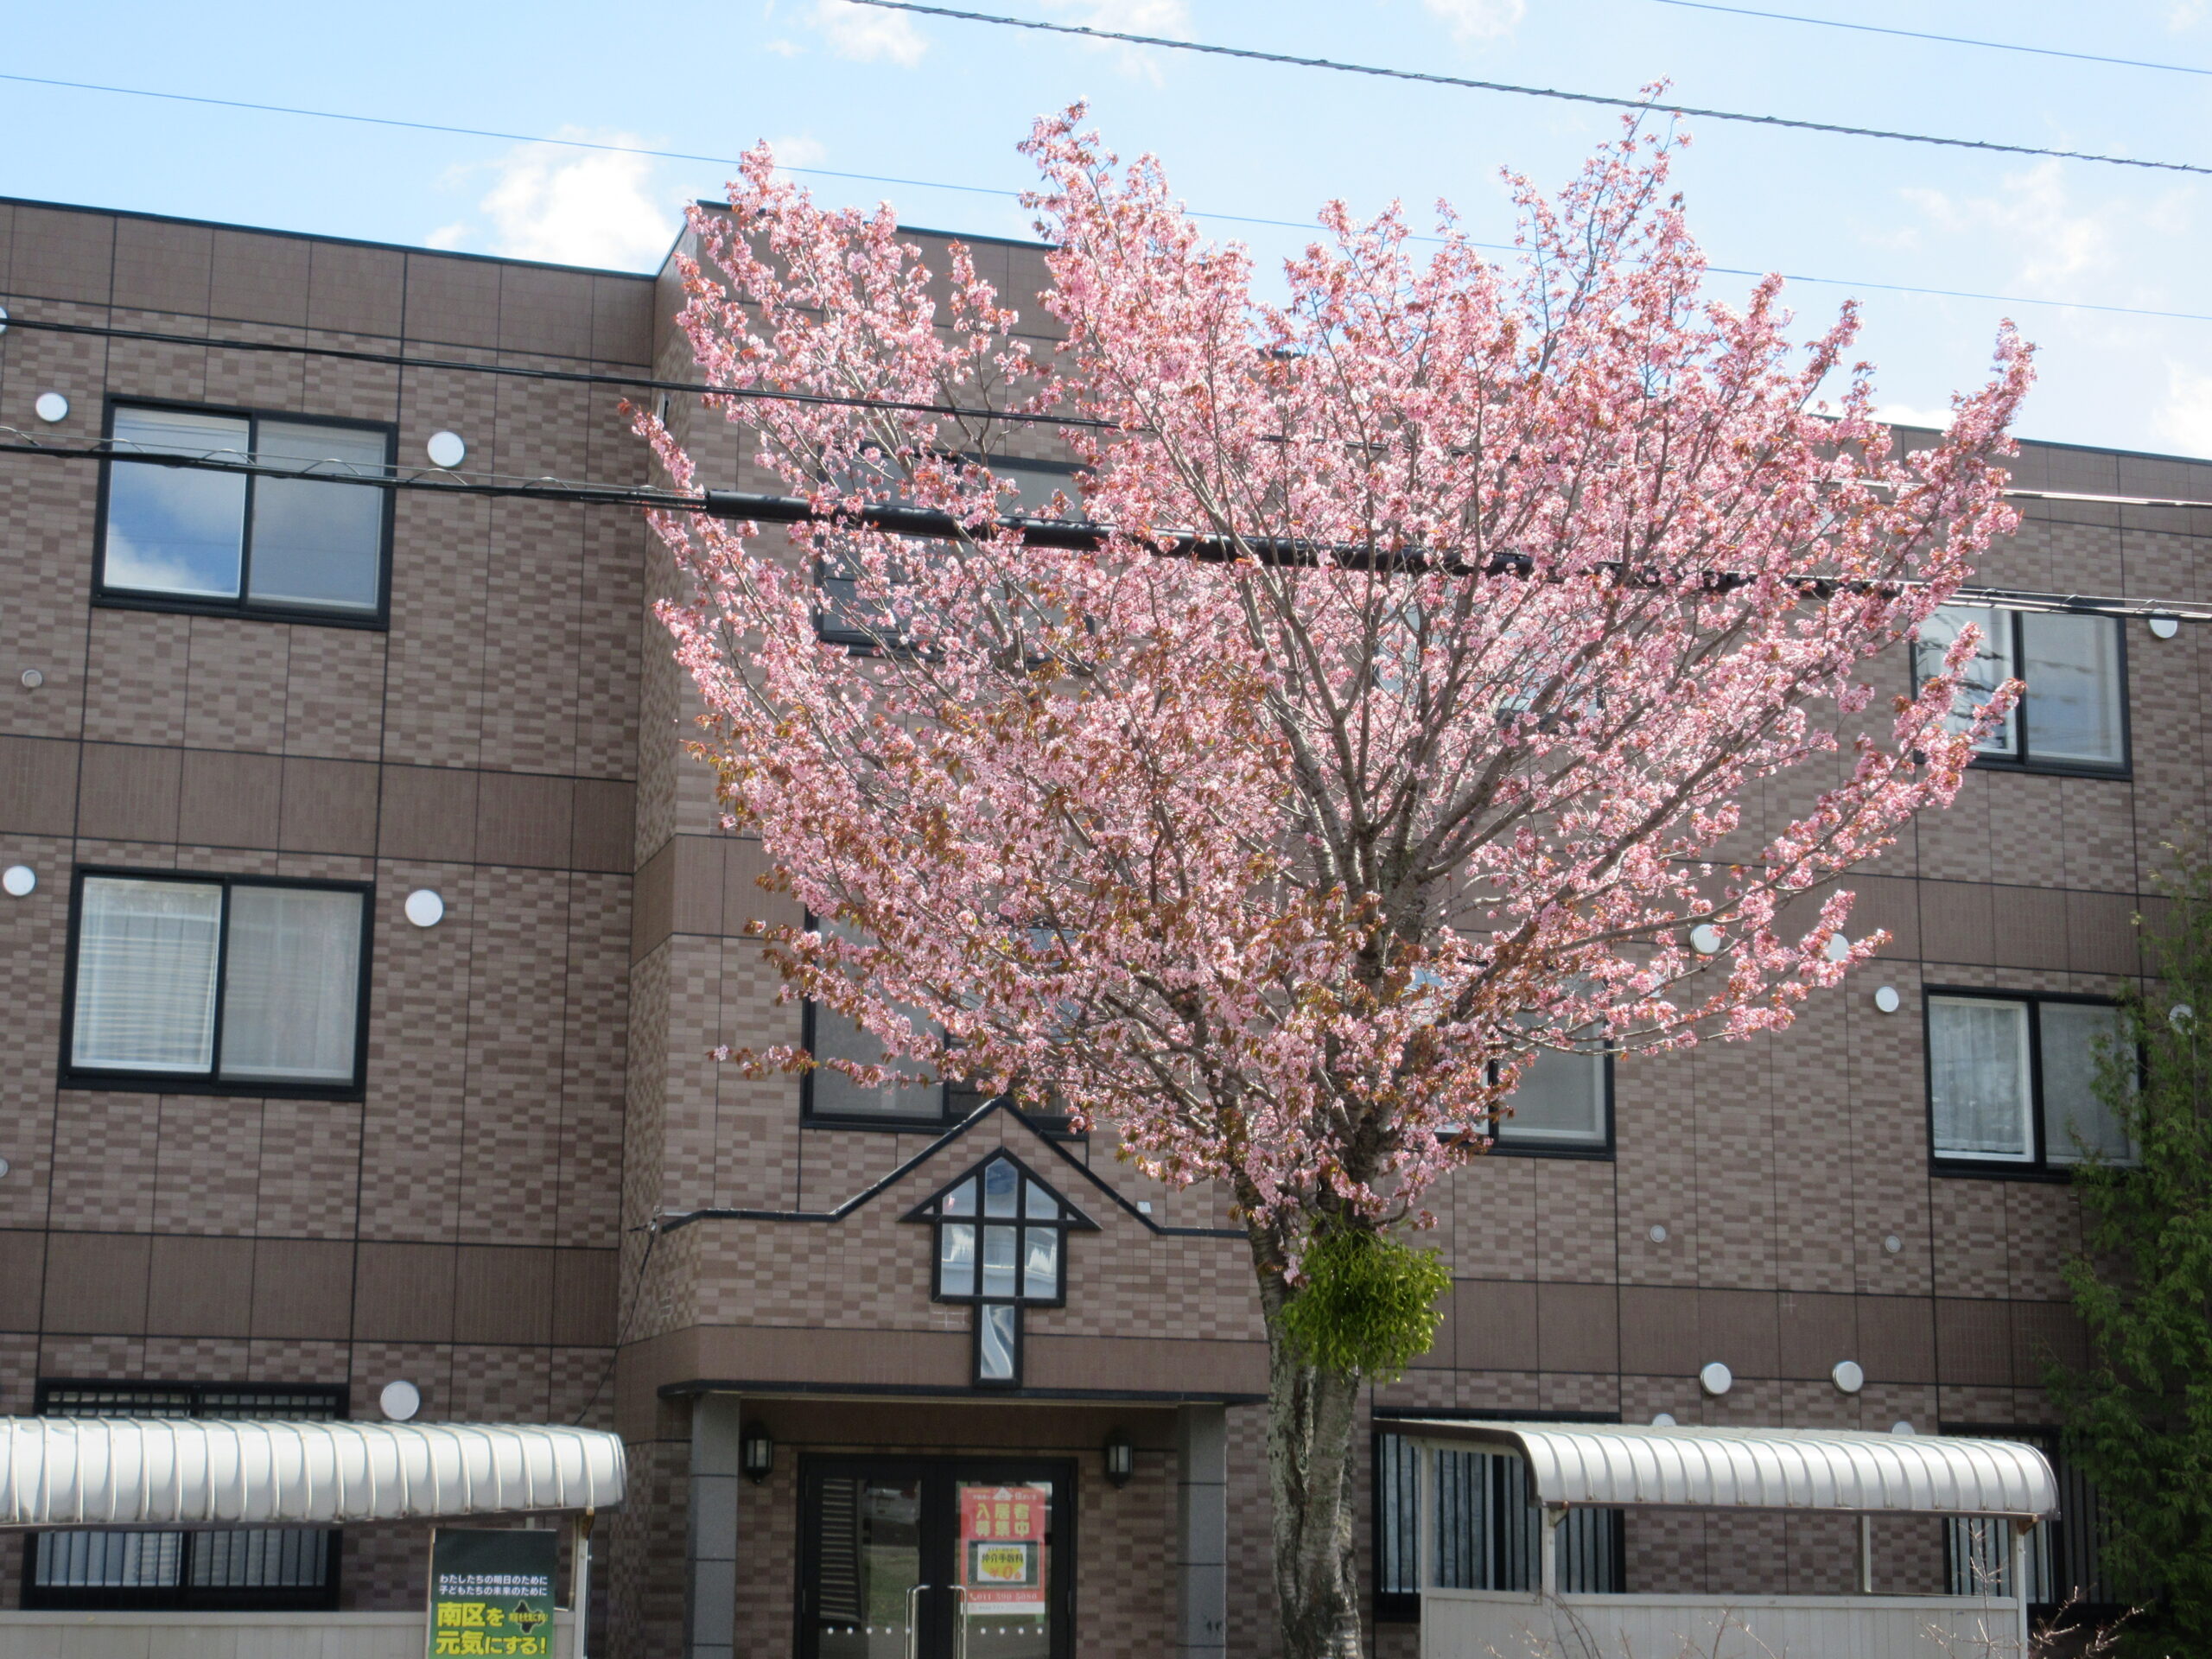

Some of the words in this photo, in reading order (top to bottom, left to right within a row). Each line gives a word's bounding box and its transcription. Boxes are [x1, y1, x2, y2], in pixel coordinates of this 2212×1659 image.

[976, 1503, 1030, 1520] 入居者
[439, 1574, 548, 1585] わたしたちの明日のために
[439, 1585, 548, 1596] 子どもたちの未来のために
[437, 1601, 505, 1627] 南区を
[435, 1630, 546, 1656] 元気にする!
